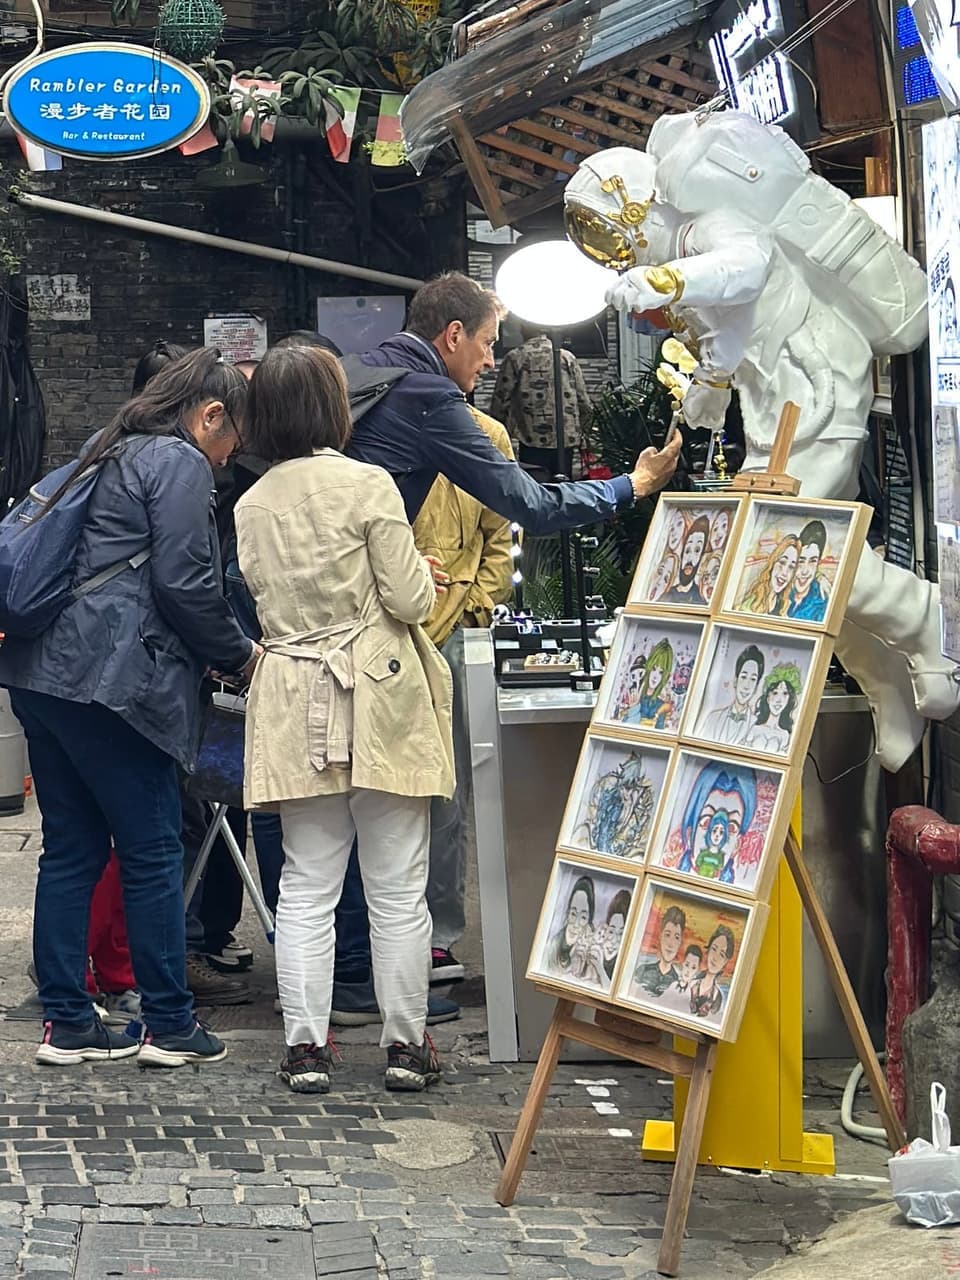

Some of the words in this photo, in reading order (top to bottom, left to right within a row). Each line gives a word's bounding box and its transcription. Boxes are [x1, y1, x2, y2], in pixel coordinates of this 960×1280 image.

[29, 78, 106, 92] Rambler
[113, 78, 181, 94] Garden
[40, 102, 170, 120] 漫步者花园
[91, 131, 145, 140] Restaurant
